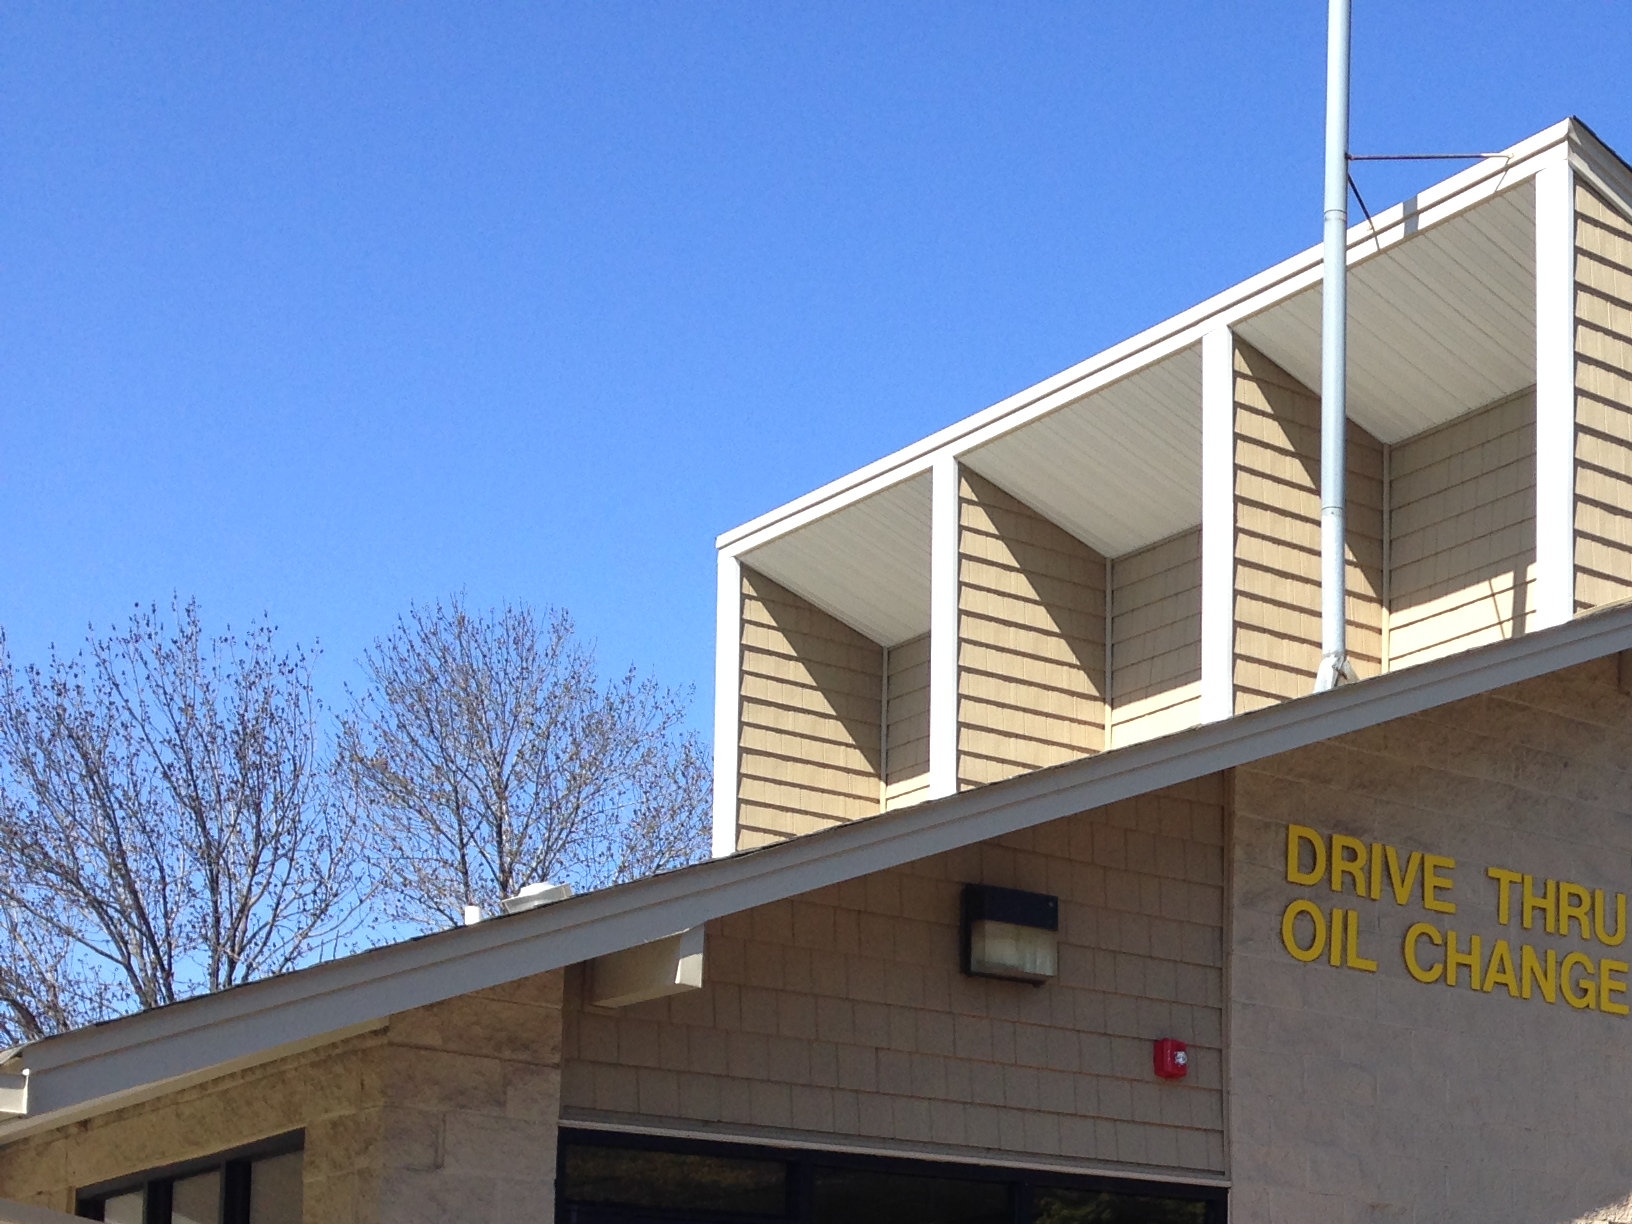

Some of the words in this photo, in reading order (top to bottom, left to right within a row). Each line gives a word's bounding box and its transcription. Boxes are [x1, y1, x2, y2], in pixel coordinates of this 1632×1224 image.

[1286, 823, 1456, 914] DRIVE
[1487, 866, 1627, 947] THRU
[1281, 899, 1378, 972] OIL
[1404, 922, 1630, 1015] CHANGE
